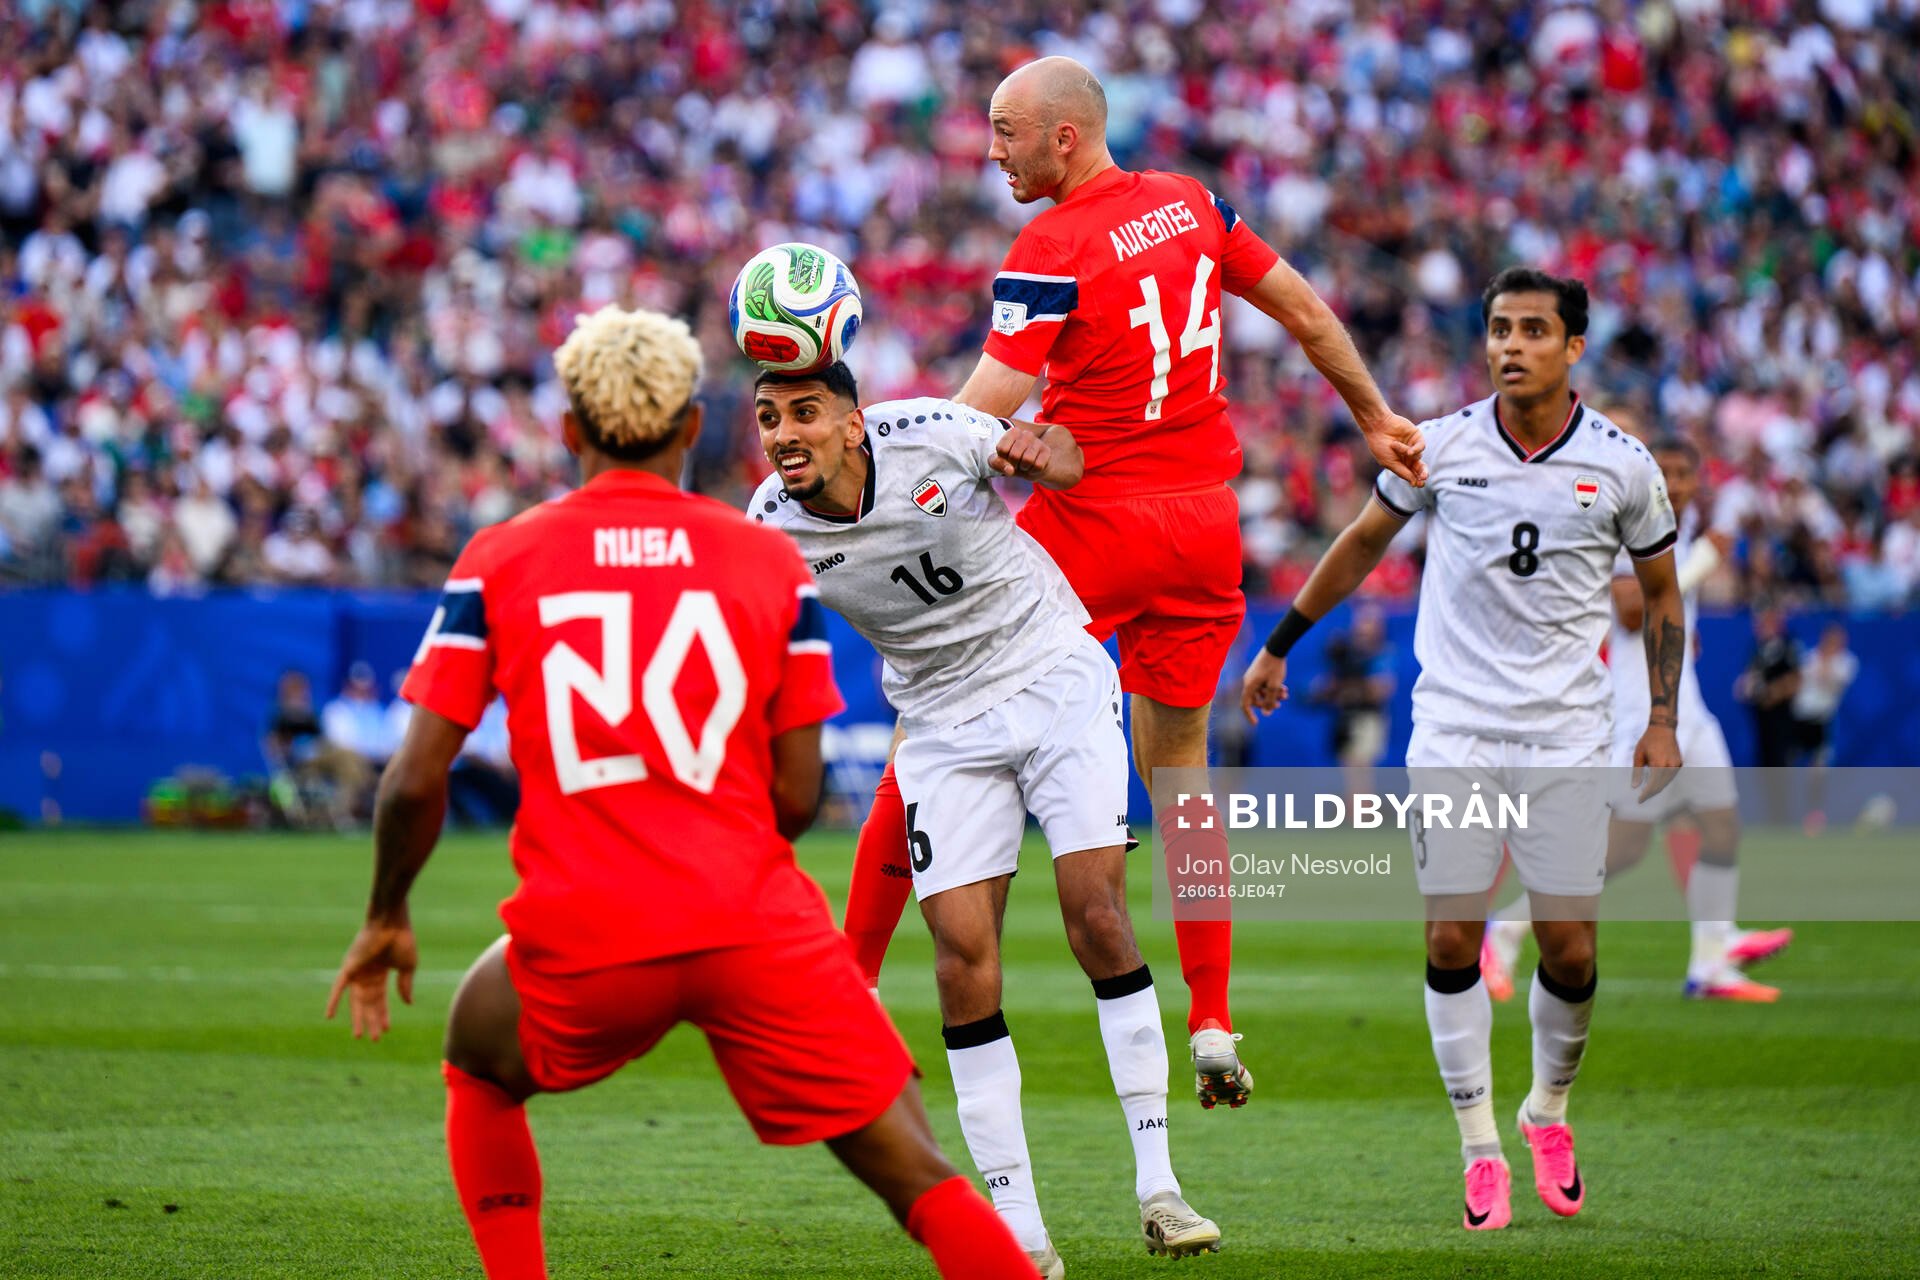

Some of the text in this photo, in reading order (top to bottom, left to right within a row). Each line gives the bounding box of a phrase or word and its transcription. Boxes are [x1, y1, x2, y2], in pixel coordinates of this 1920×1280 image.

[1128, 253, 1220, 421] 14
[915, 482, 931, 496] IRAQ
[1457, 477, 1488, 488] JAKO
[594, 527, 694, 567] NUSA
[813, 552, 845, 575] JAKO
[1509, 522, 1539, 577] 8
[889, 551, 964, 606] 16
[538, 590, 748, 796] 20
